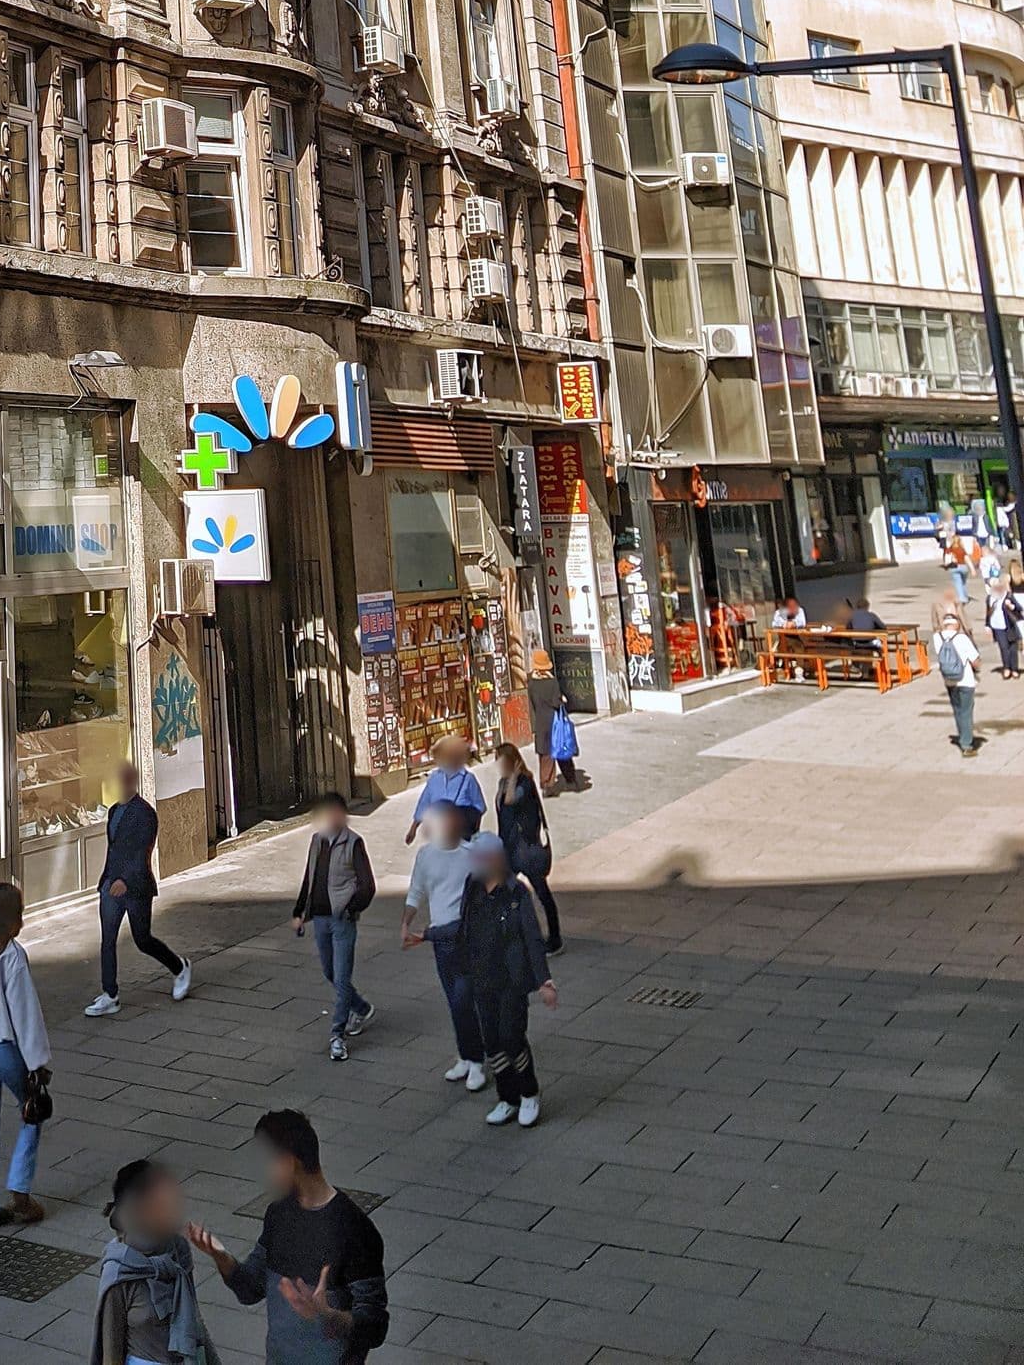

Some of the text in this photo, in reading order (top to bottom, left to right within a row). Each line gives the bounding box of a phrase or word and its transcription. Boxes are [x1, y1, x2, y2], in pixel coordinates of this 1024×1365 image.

[903, 431, 955, 446] АПОТЕКА
[517, 451, 532, 532] ZLATARA
[14, 523, 118, 555] DOMINO SHOP
[543, 528, 565, 634] BRAVAR
